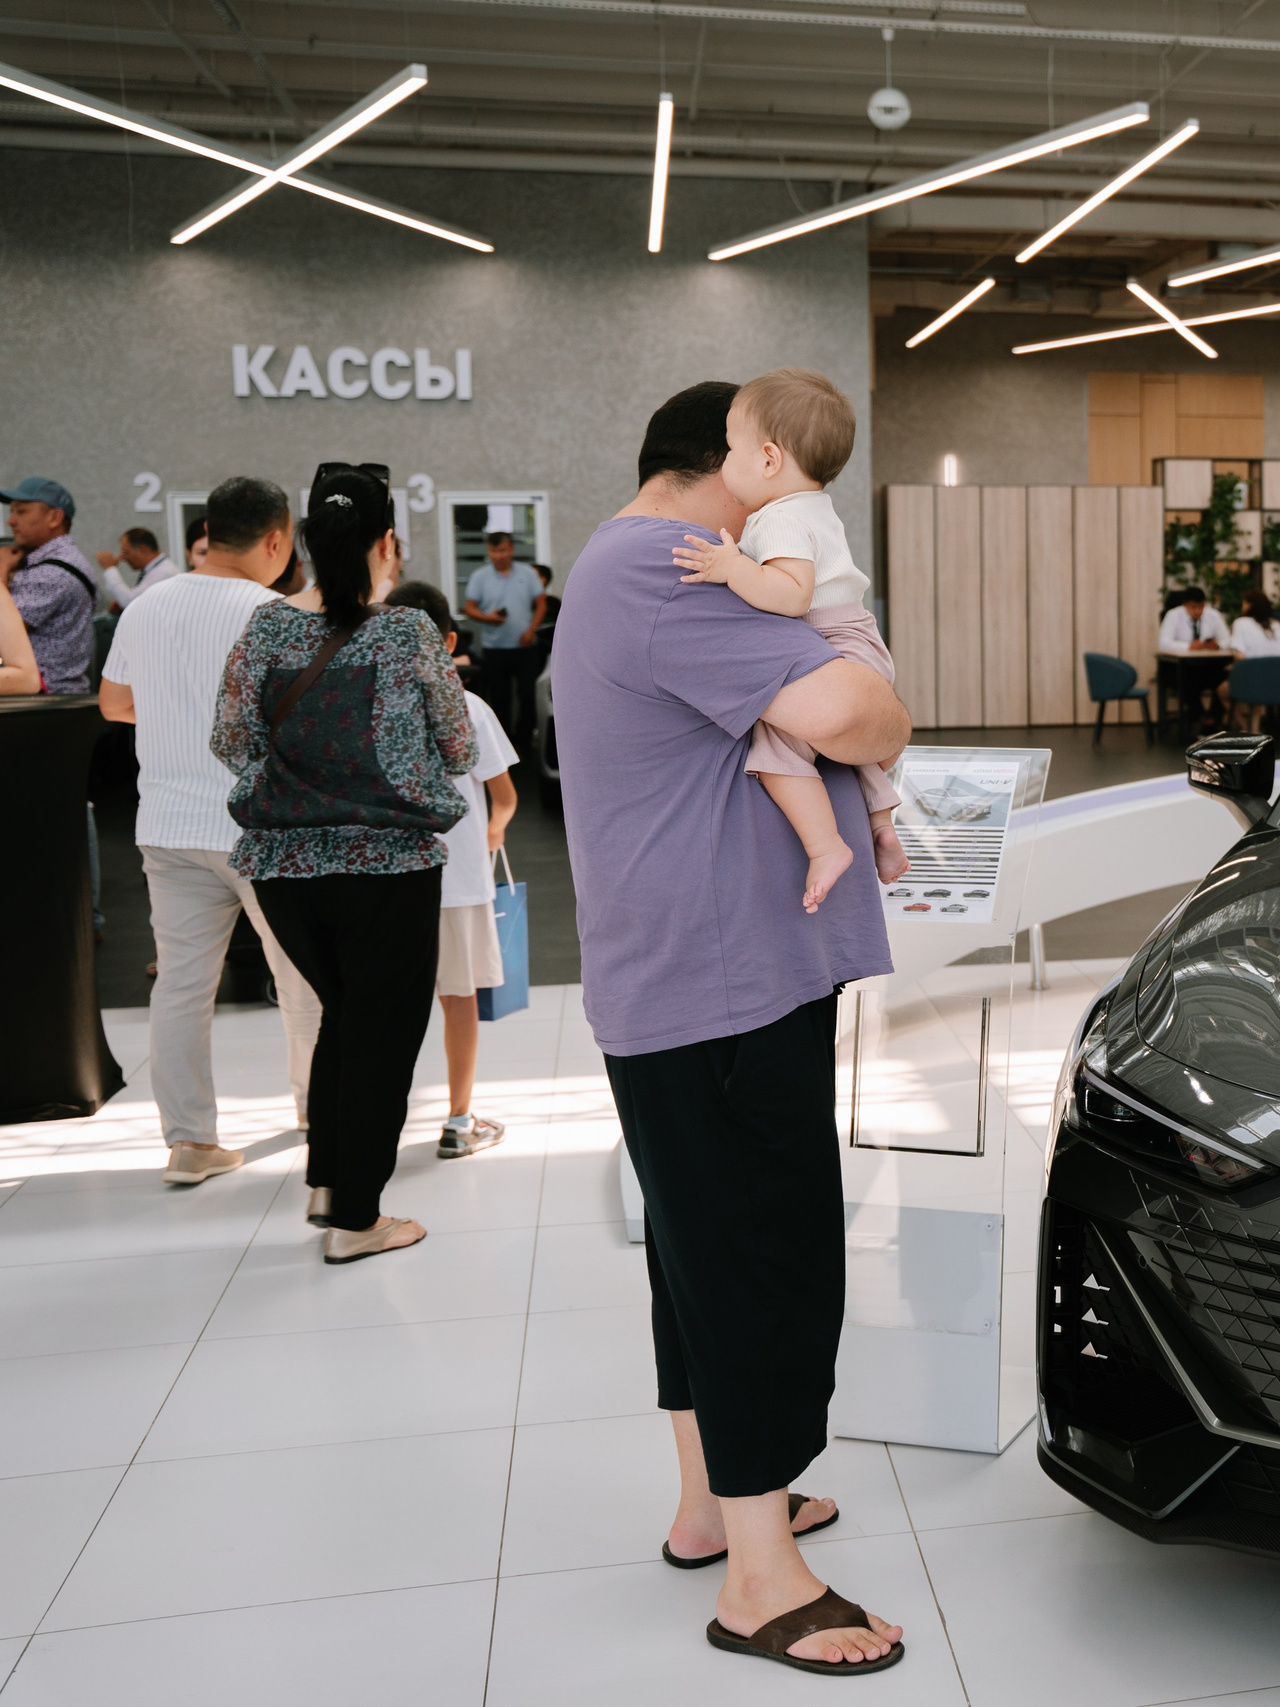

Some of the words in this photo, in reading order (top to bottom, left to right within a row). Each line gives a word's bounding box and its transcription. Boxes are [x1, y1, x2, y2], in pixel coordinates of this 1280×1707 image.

[232, 344, 473, 401] КАССЫ
[133, 471, 163, 513] 2
[406, 472, 435, 514] 3
